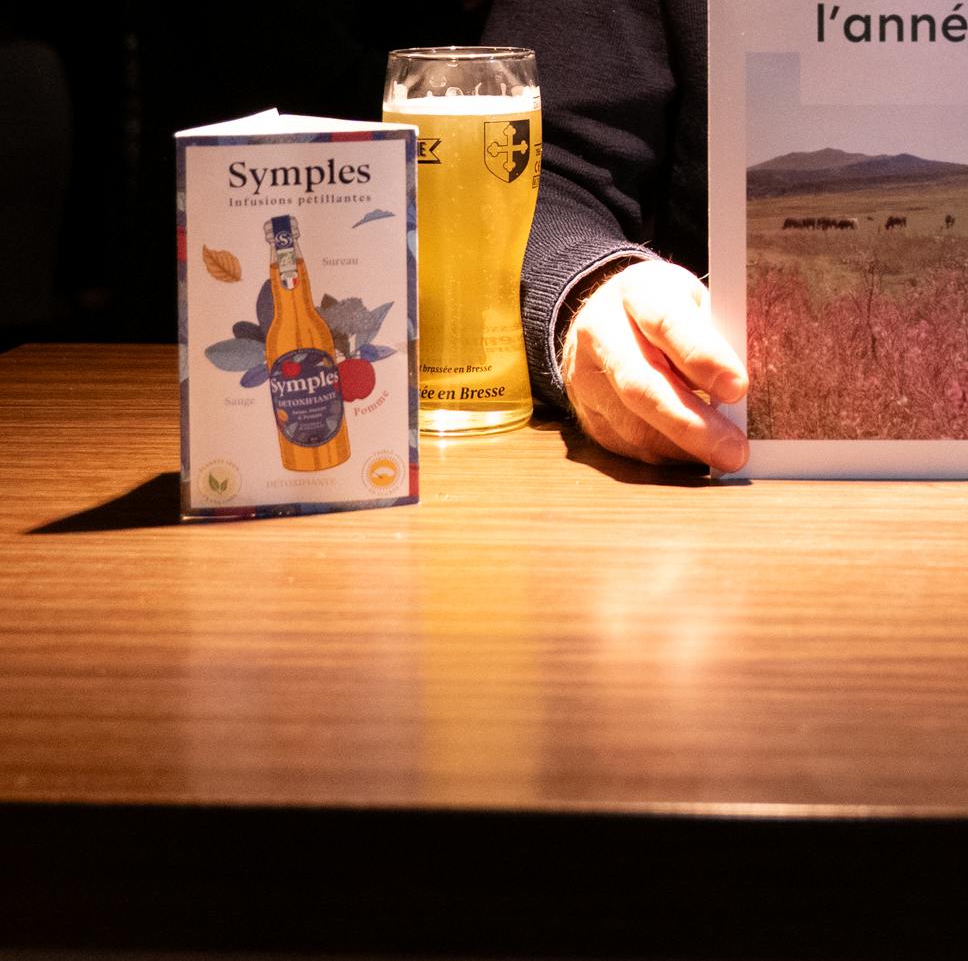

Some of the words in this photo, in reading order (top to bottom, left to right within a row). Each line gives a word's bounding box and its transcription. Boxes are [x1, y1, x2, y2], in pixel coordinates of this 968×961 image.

[228, 158, 372, 195] Symples
[229, 197, 293, 207] Infusions
[322, 256, 359, 266] Sureau
[453, 365, 465, 373] en
[466, 364, 492, 373] Bresse
[270, 371, 339, 397] Symples
[437, 389, 456, 400] en
[460, 386, 506, 400] Bresse
[224, 396, 256, 407] Sauge
[353, 390, 390, 417] Pomme
